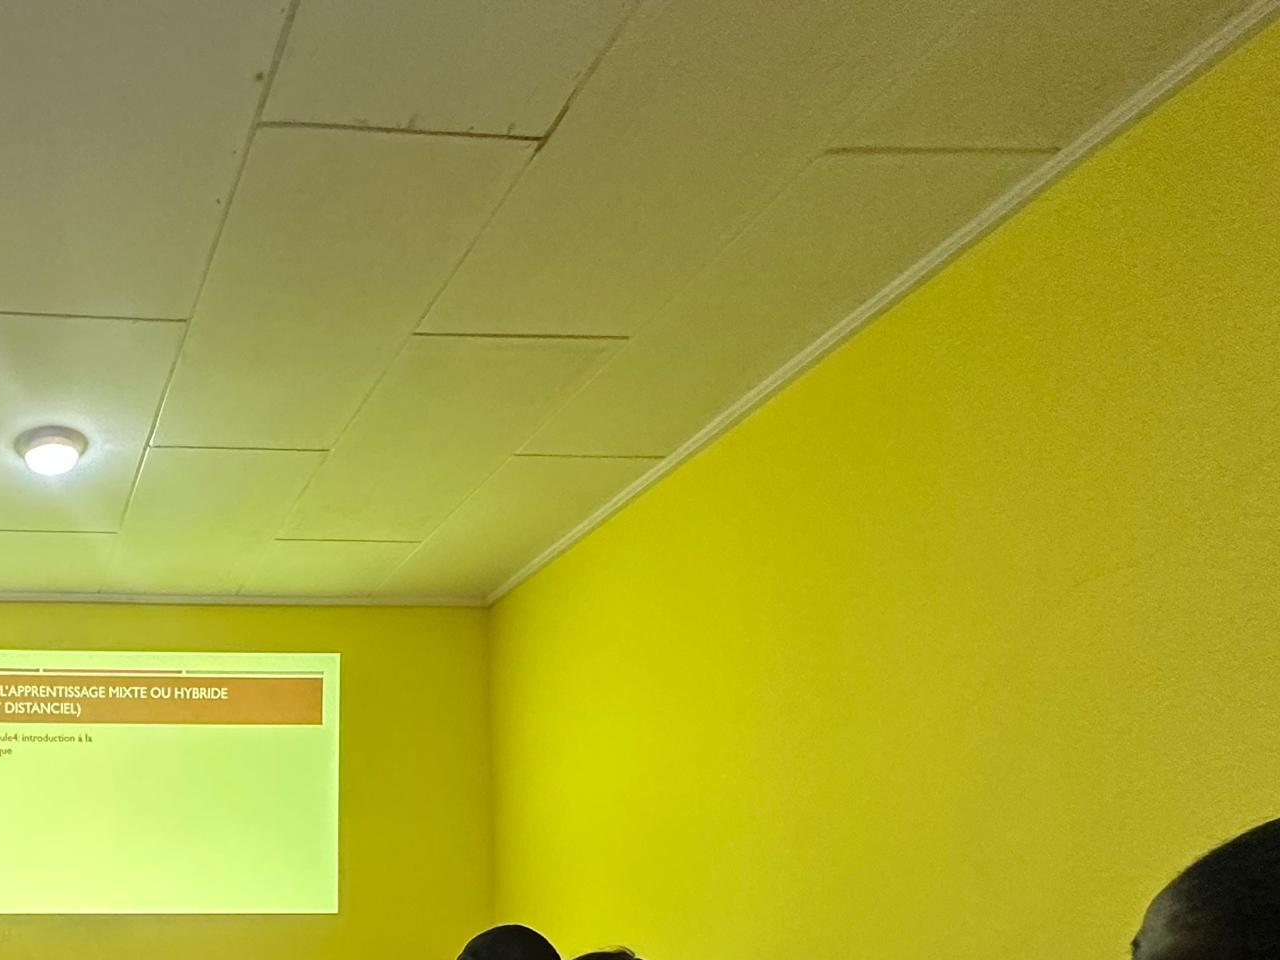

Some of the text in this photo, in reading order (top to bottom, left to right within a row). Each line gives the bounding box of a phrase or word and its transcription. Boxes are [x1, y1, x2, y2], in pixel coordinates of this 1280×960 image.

[0, 685, 106, 698] L'APPRENTISSAGE
[109, 686, 147, 698] MIXTE
[150, 687, 171, 699] OU
[174, 687, 228, 700] HYBRIDE
[5, 702, 81, 717] DISTANCIEL)
[21, 733, 75, 743] introduction
[85, 733, 93, 743] la
